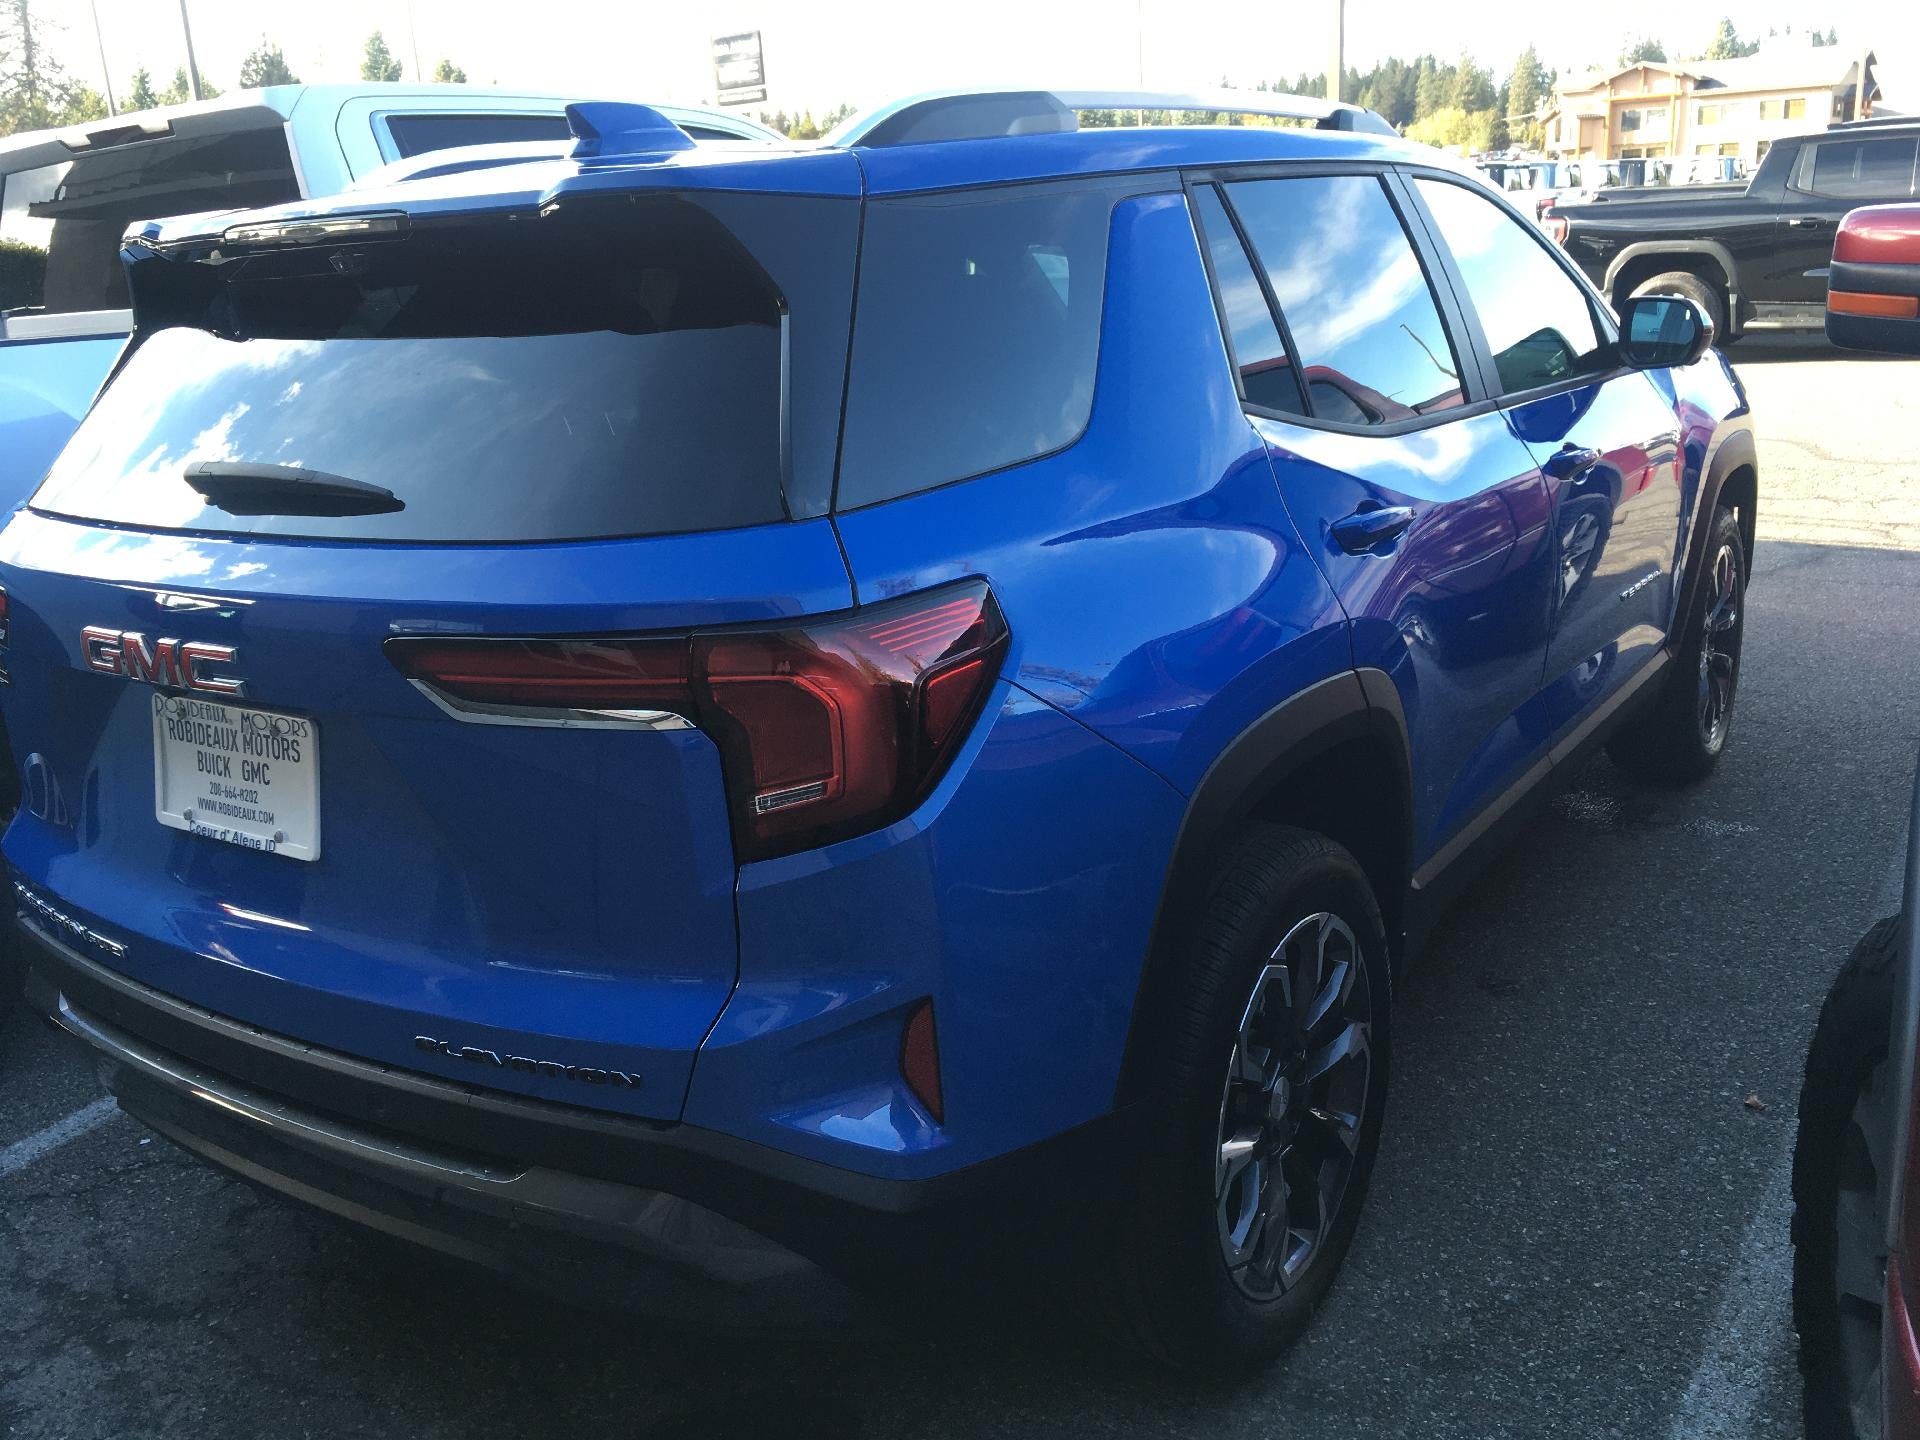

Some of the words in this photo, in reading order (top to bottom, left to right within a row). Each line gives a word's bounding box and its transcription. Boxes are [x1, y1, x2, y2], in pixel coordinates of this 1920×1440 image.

[80, 625, 246, 697] GMC
[168, 718, 239, 752] ROBIDEAUX
[243, 732, 301, 763] MOTORS
[197, 751, 231, 778] BUICK
[241, 760, 270, 785] GMC
[198, 797, 275, 825] WWW.ROBIDEAUX.COM
[189, 820, 218, 838] Coeur
[232, 831, 261, 849] Alene
[265, 839, 276, 851] ID
